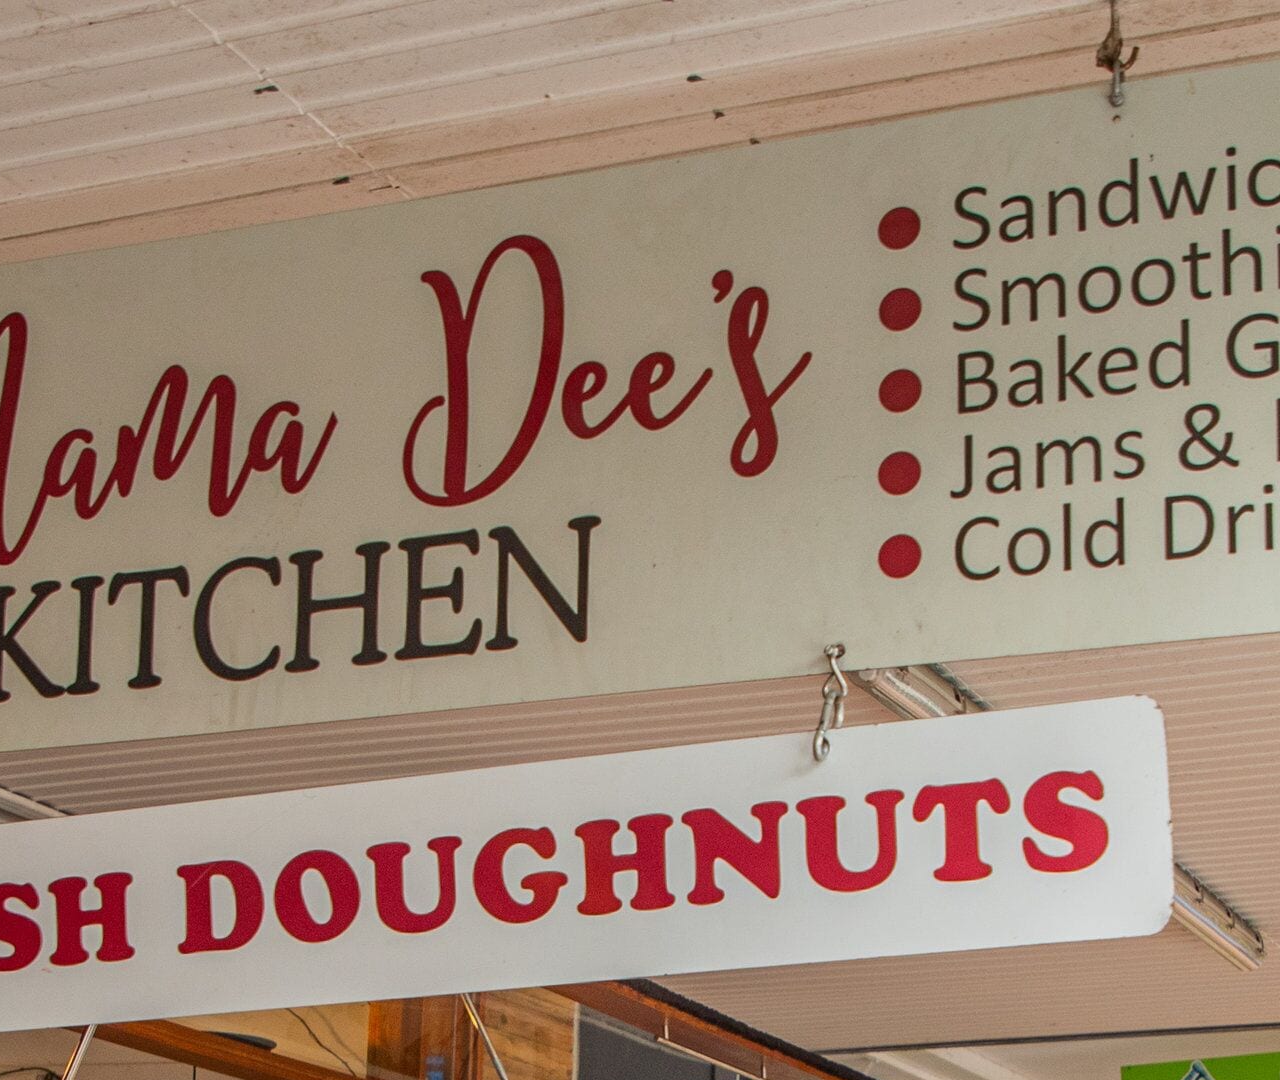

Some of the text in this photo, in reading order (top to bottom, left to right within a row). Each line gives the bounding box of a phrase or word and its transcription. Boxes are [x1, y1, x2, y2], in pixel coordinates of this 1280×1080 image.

[402, 234, 813, 508] Dee's
[955, 318, 1193, 416] Baked
[948, 428, 1147, 500] Jams
[1177, 402, 1240, 473] &
[954, 497, 1126, 582] Cold
[176, 769, 1110, 956] DOUGHNUTS
